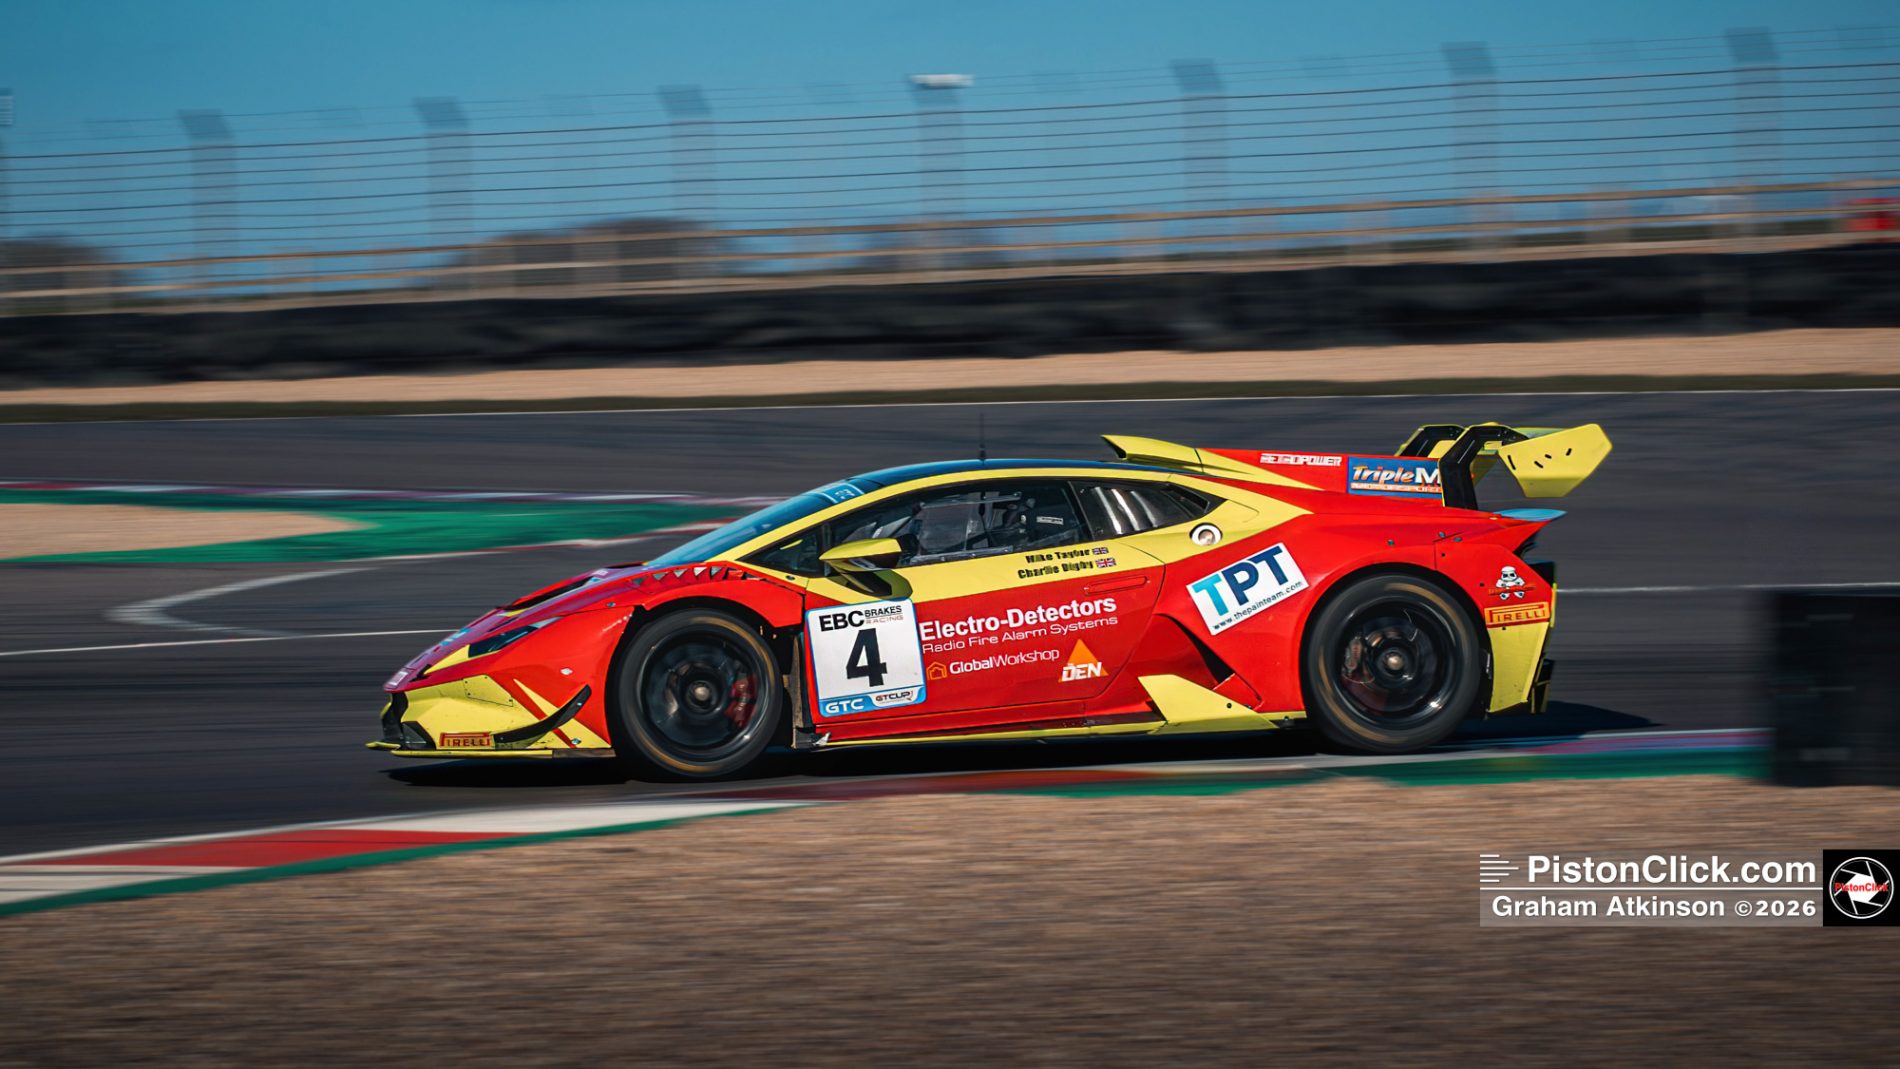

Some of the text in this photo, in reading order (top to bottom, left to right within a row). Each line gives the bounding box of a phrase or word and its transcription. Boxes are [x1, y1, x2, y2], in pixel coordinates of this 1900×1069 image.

[1018, 565, 1059, 579] Charlie
[1191, 545, 1288, 616] TPT
[1213, 581, 1302, 630] www.thepainteam.com
[1489, 604, 1545, 623] PIRELLI
[819, 605, 903, 632] EBC BRAKES
[866, 616, 903, 624] RACING
[919, 598, 1117, 641] Electro-Detectors
[922, 616, 1118, 654] Radio Fire Alarm Systems
[846, 628, 888, 687] 4
[950, 649, 1059, 674] GlobalWorkshop
[1062, 661, 1102, 682] DEN
[825, 699, 864, 713] GTC
[440, 732, 490, 747] PIRELLI
